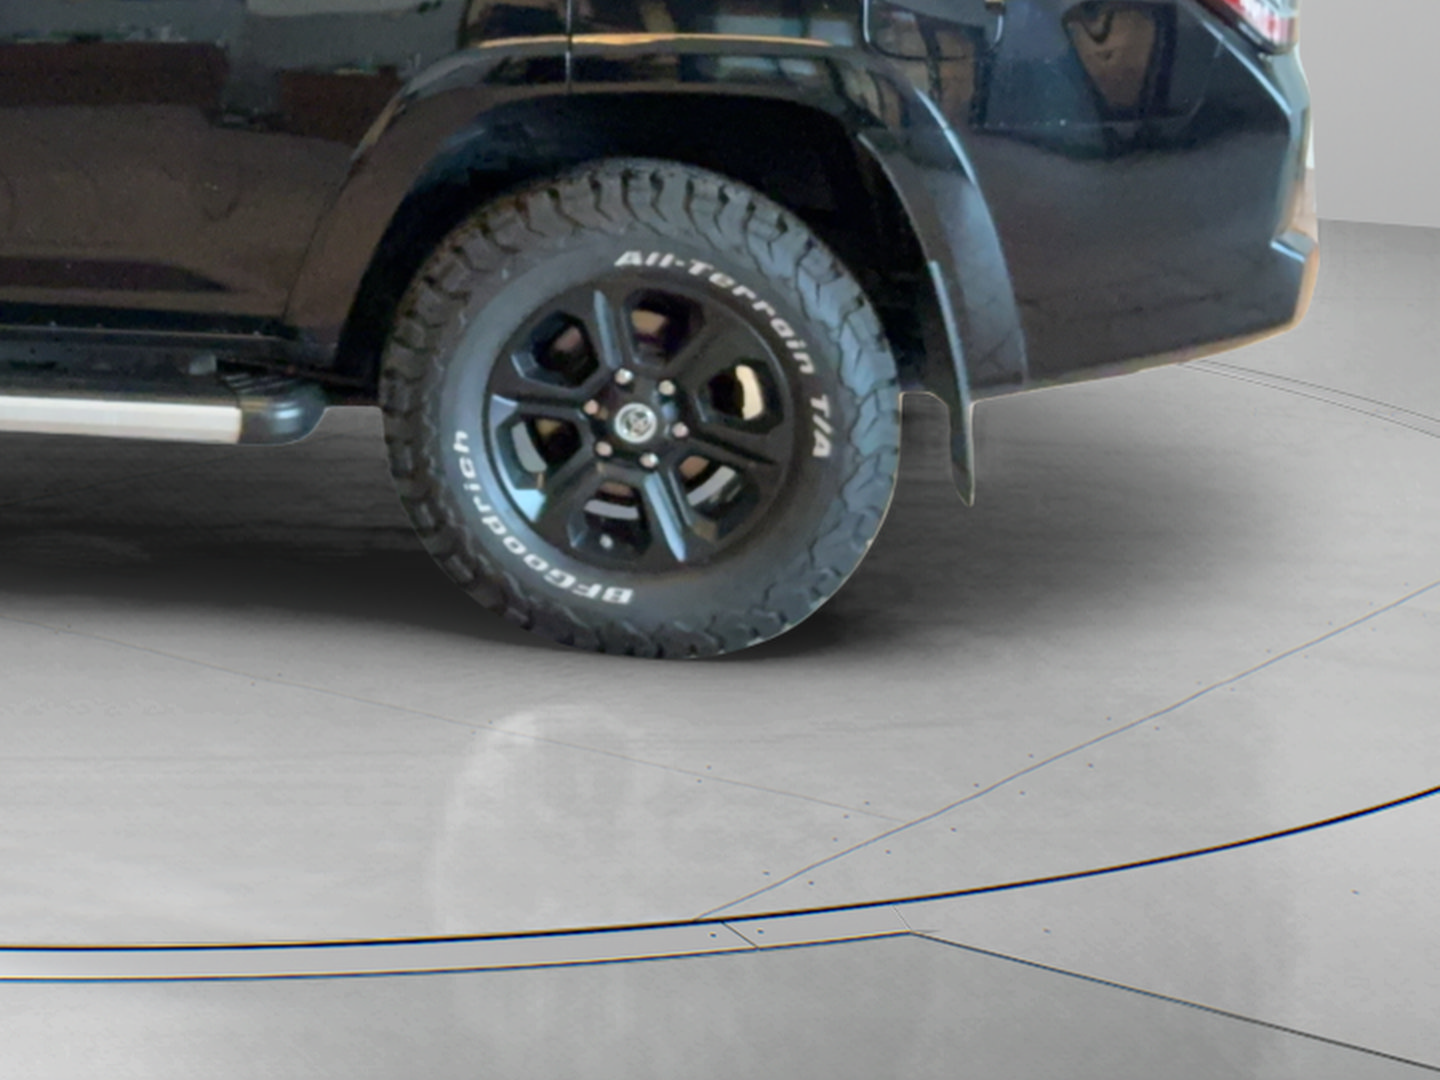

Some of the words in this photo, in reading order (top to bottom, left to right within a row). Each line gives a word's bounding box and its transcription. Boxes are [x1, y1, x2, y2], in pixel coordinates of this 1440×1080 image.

[614, 250, 816, 376] All-Terrain
[809, 393, 833, 459] T/A
[452, 431, 635, 606] BFGoodrich
